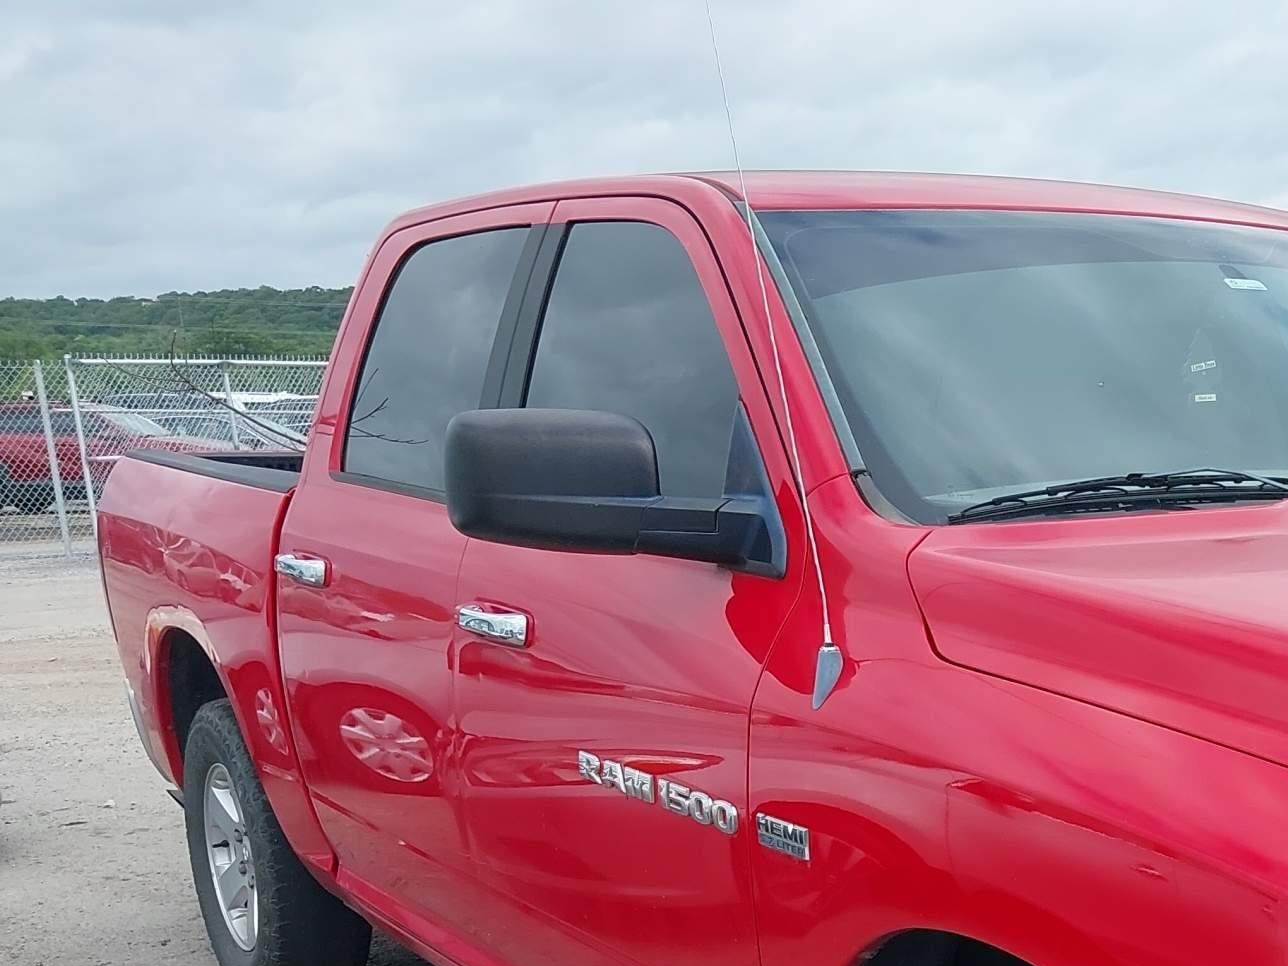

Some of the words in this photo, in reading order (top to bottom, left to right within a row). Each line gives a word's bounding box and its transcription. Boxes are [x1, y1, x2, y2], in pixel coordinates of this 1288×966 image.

[578, 750, 655, 803] RAM
[658, 779, 738, 834] 1500
[757, 815, 806, 846] HEMI
